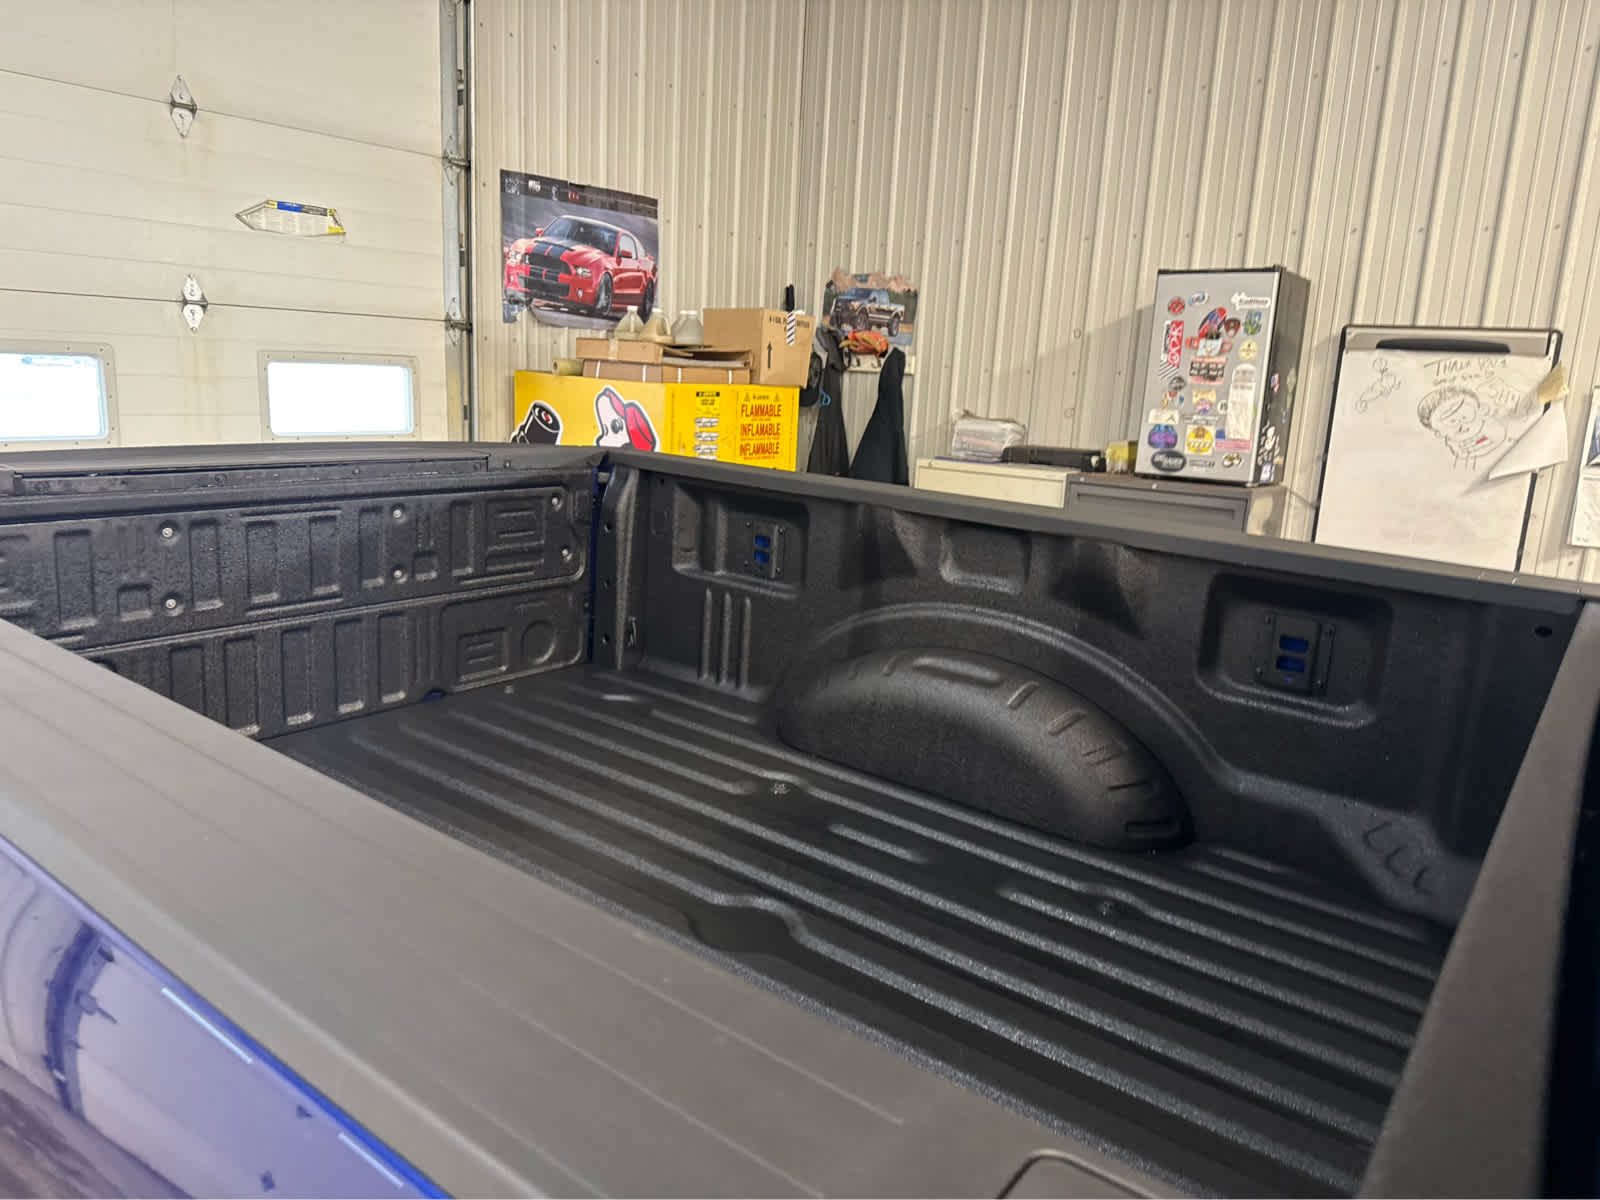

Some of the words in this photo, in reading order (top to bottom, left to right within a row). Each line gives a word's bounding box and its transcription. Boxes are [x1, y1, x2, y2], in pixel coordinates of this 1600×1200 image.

[740, 404, 782, 417] FLAMMABLE
[740, 422, 780, 437] INFLAMABLE
[740, 441, 780, 457] INFLAMMABLE
